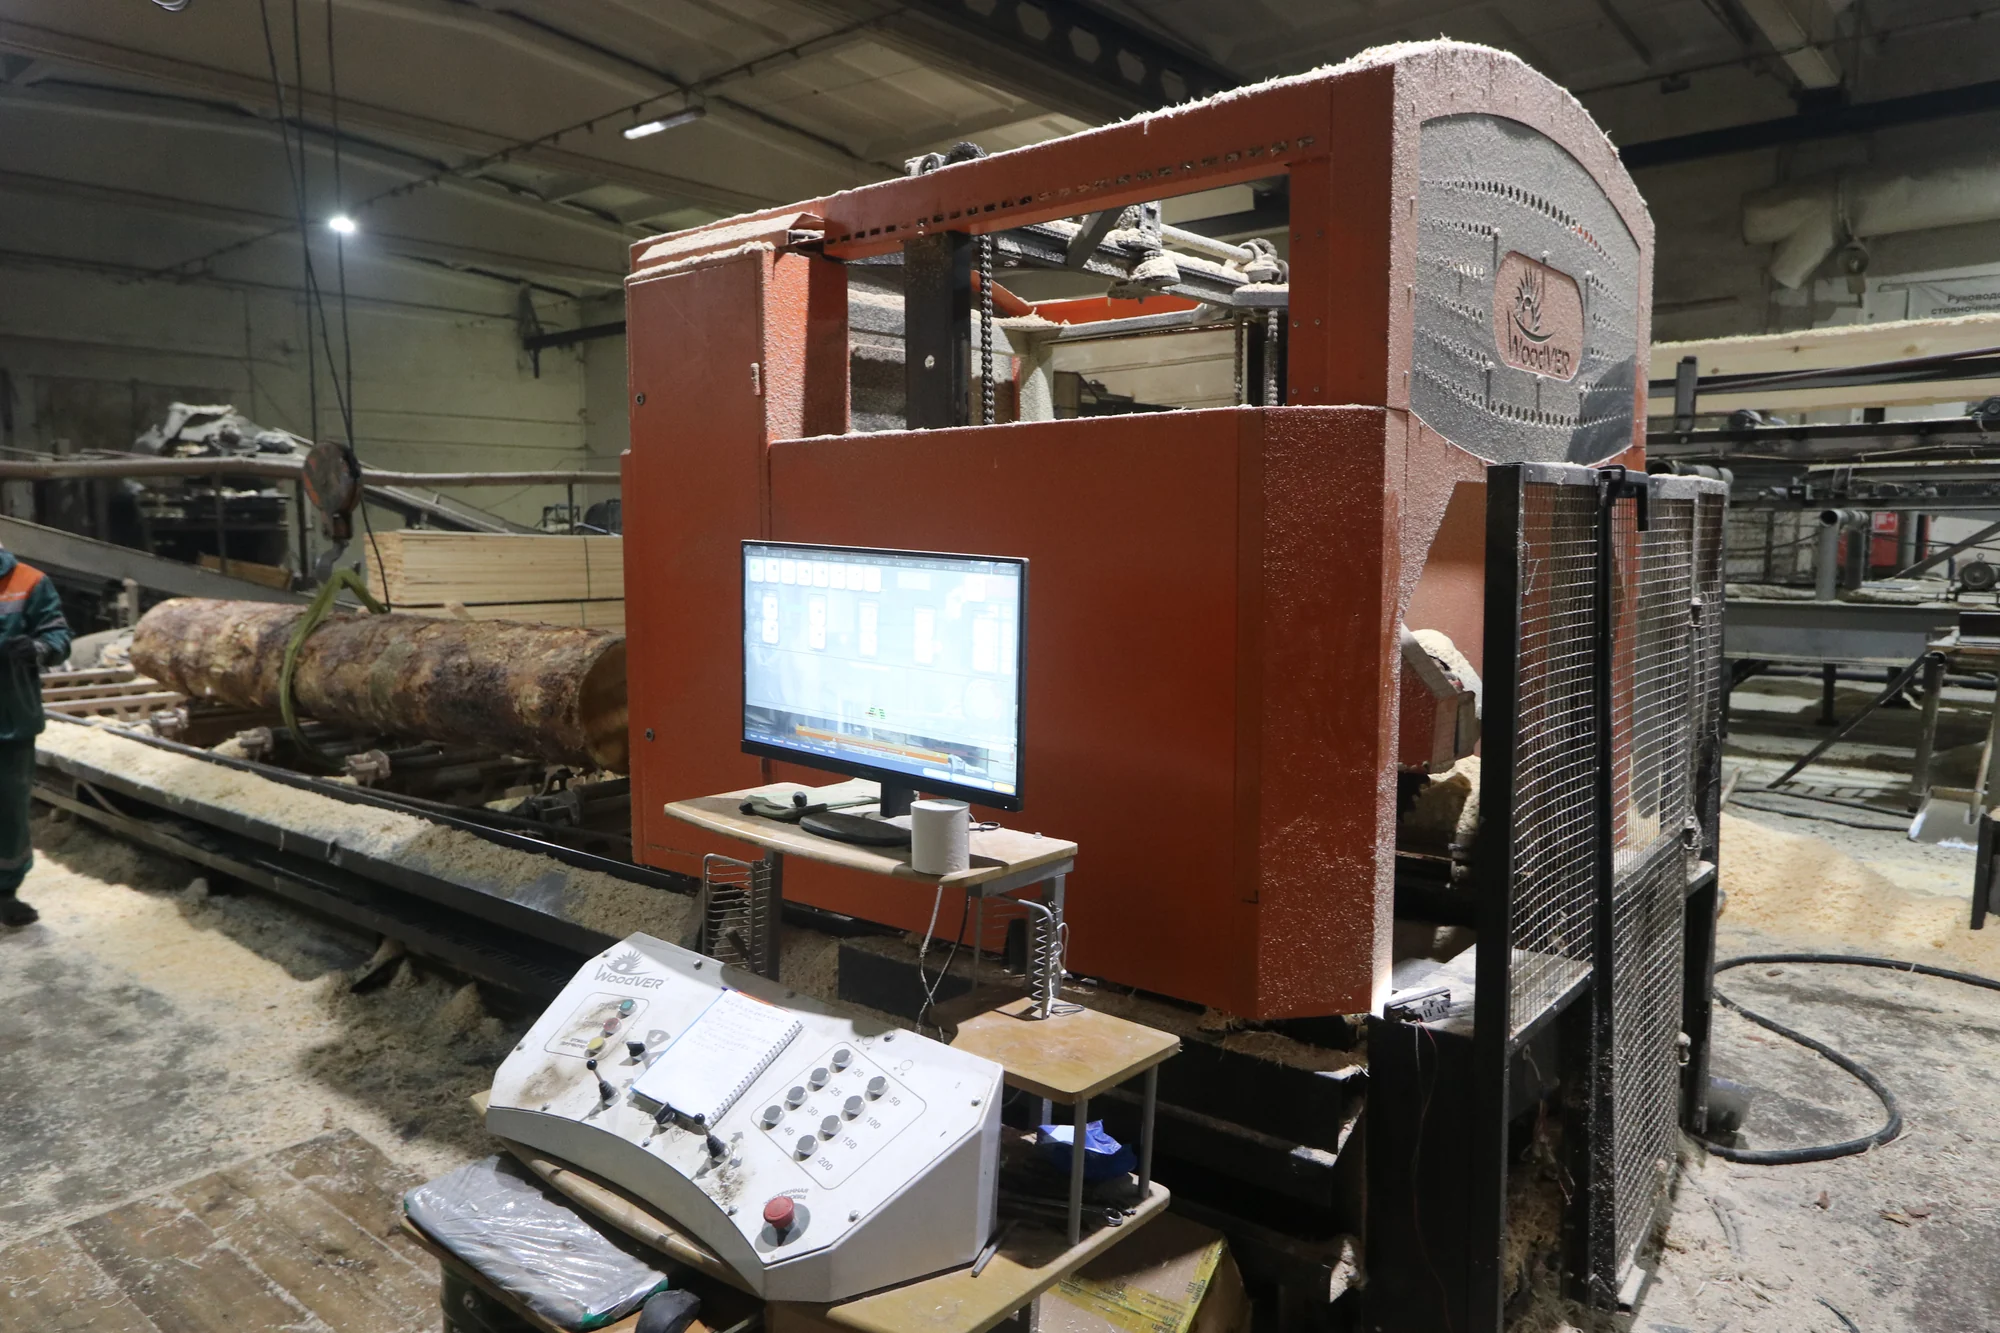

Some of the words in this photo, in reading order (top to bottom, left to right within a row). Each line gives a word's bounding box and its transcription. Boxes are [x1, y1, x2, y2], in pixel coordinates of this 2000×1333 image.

[594, 963, 664, 990] WoodVER
[853, 1068, 864, 1078] 20
[830, 1087, 842, 1097] 25
[889, 1096, 901, 1107] 50
[807, 1106, 819, 1117] 30
[866, 1116, 881, 1130] 100
[784, 1126, 795, 1136] 40
[842, 1136, 858, 1150] 150
[817, 1156, 833, 1171] 200
